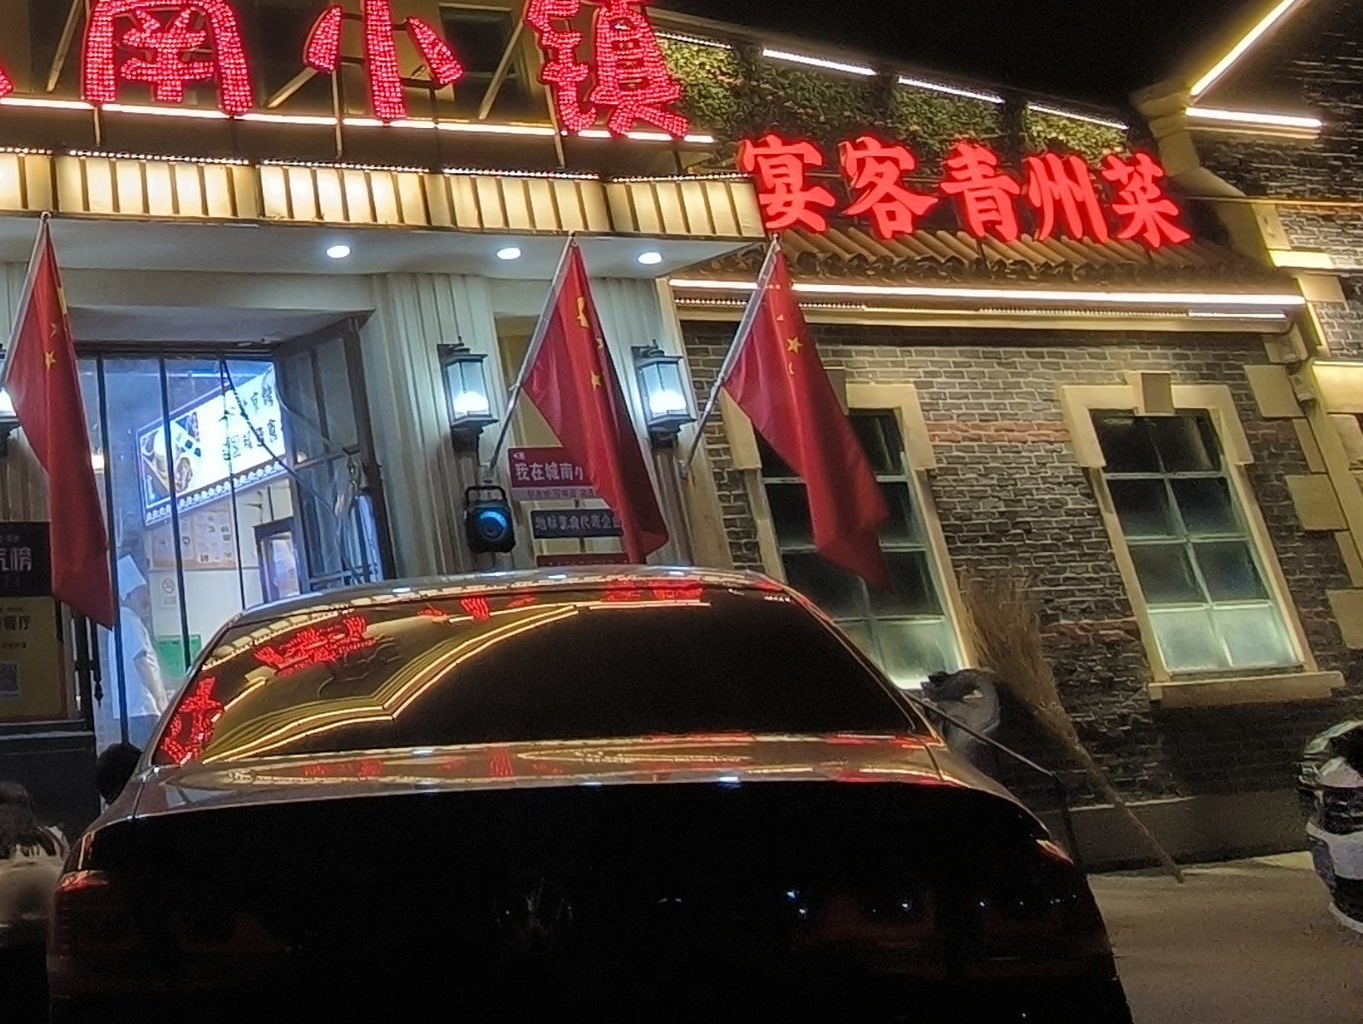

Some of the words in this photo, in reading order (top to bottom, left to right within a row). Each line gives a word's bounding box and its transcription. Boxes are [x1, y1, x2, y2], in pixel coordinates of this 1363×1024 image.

[741, 134, 1192, 249] 宴客青州菜
